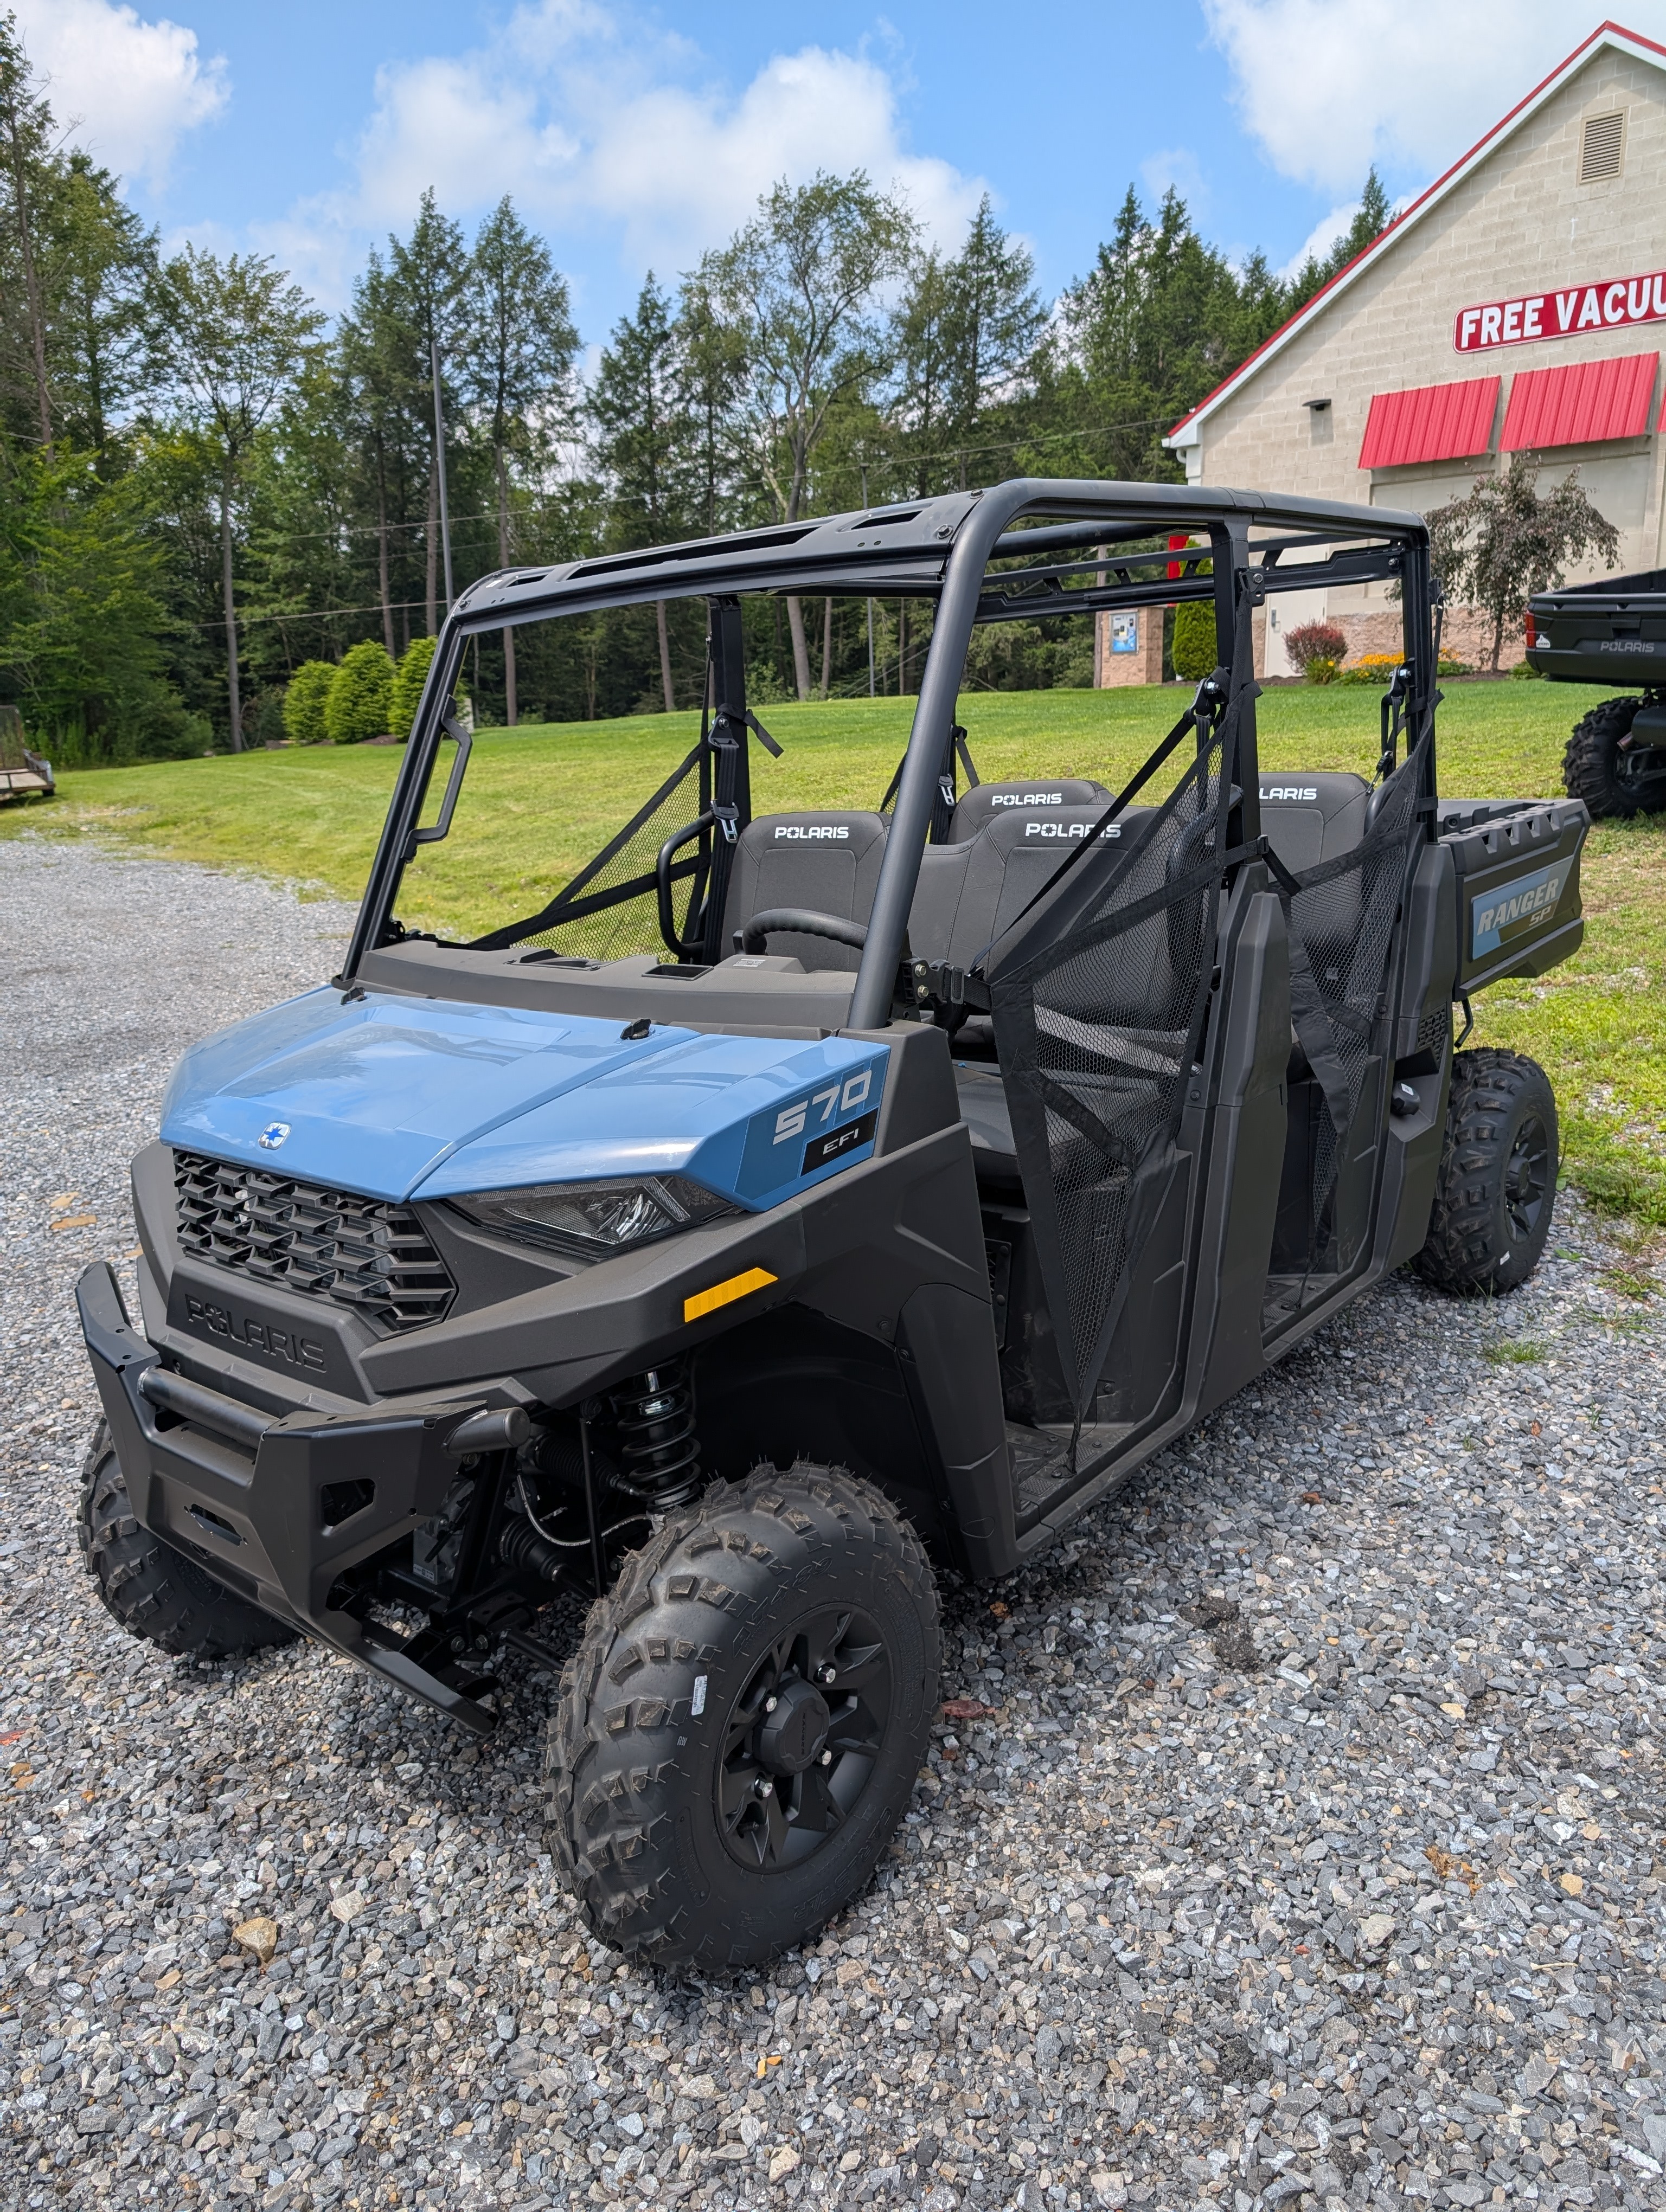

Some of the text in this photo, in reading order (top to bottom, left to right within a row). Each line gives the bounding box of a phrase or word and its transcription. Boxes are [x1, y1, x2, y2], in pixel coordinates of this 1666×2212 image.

[1461, 297, 1544, 349] FREE
[1600, 641, 1655, 653] POLARIS
[991, 793, 1062, 806] POLARIS
[1259, 787, 1317, 800] LARIS
[774, 826, 849, 839] POLARIS
[1477, 878, 1559, 936] RANGER
[1529, 905, 1551, 927] SP
[823, 1128, 859, 1155] EFI
[184, 1294, 327, 1373] POLARIS
